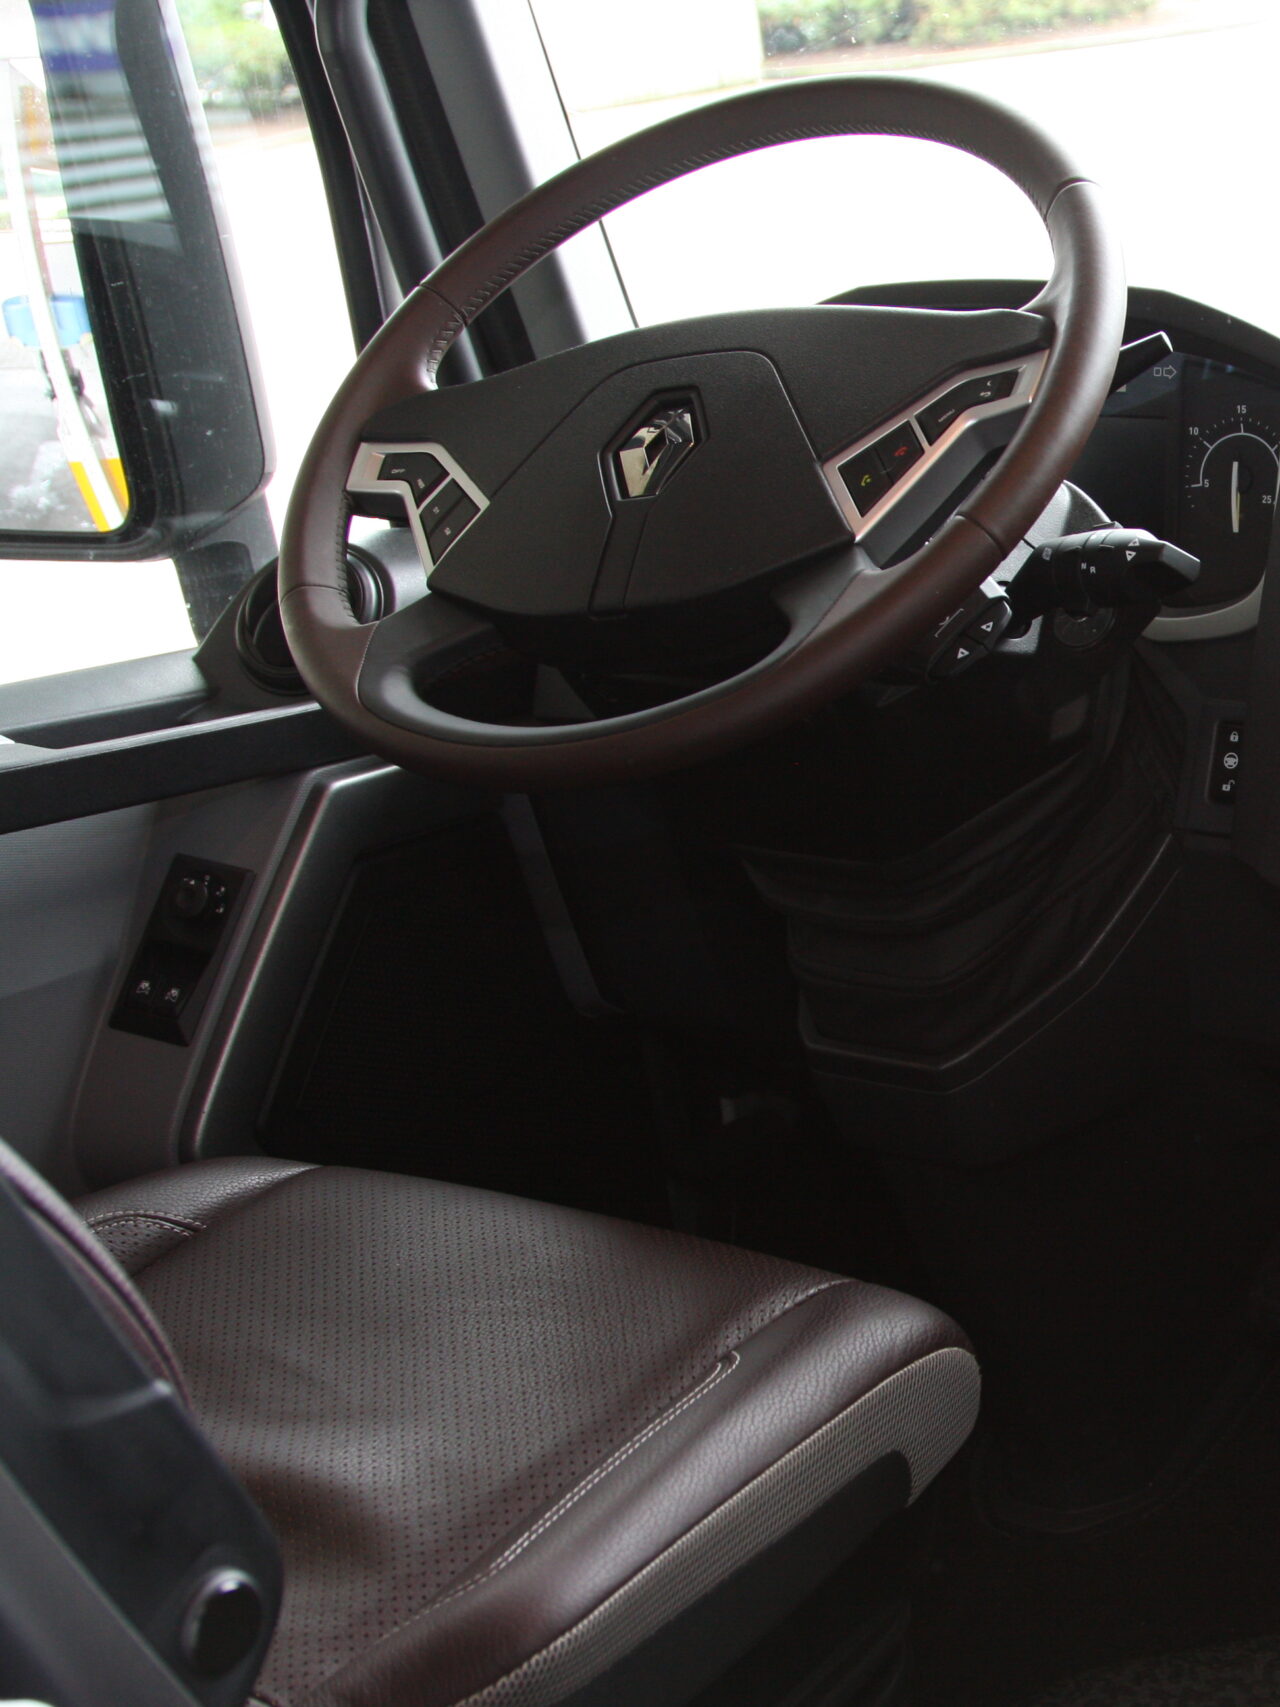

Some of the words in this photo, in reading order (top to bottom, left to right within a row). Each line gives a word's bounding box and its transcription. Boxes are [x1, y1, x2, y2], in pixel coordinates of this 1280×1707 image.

[1236, 405, 1247, 414] 15
[1188, 427, 1199, 436] 10
[1204, 479, 1210, 488] 5
[1262, 495, 1272, 504] 25
[1081, 562, 1087, 570] N
[1089, 565, 1096, 574] R
